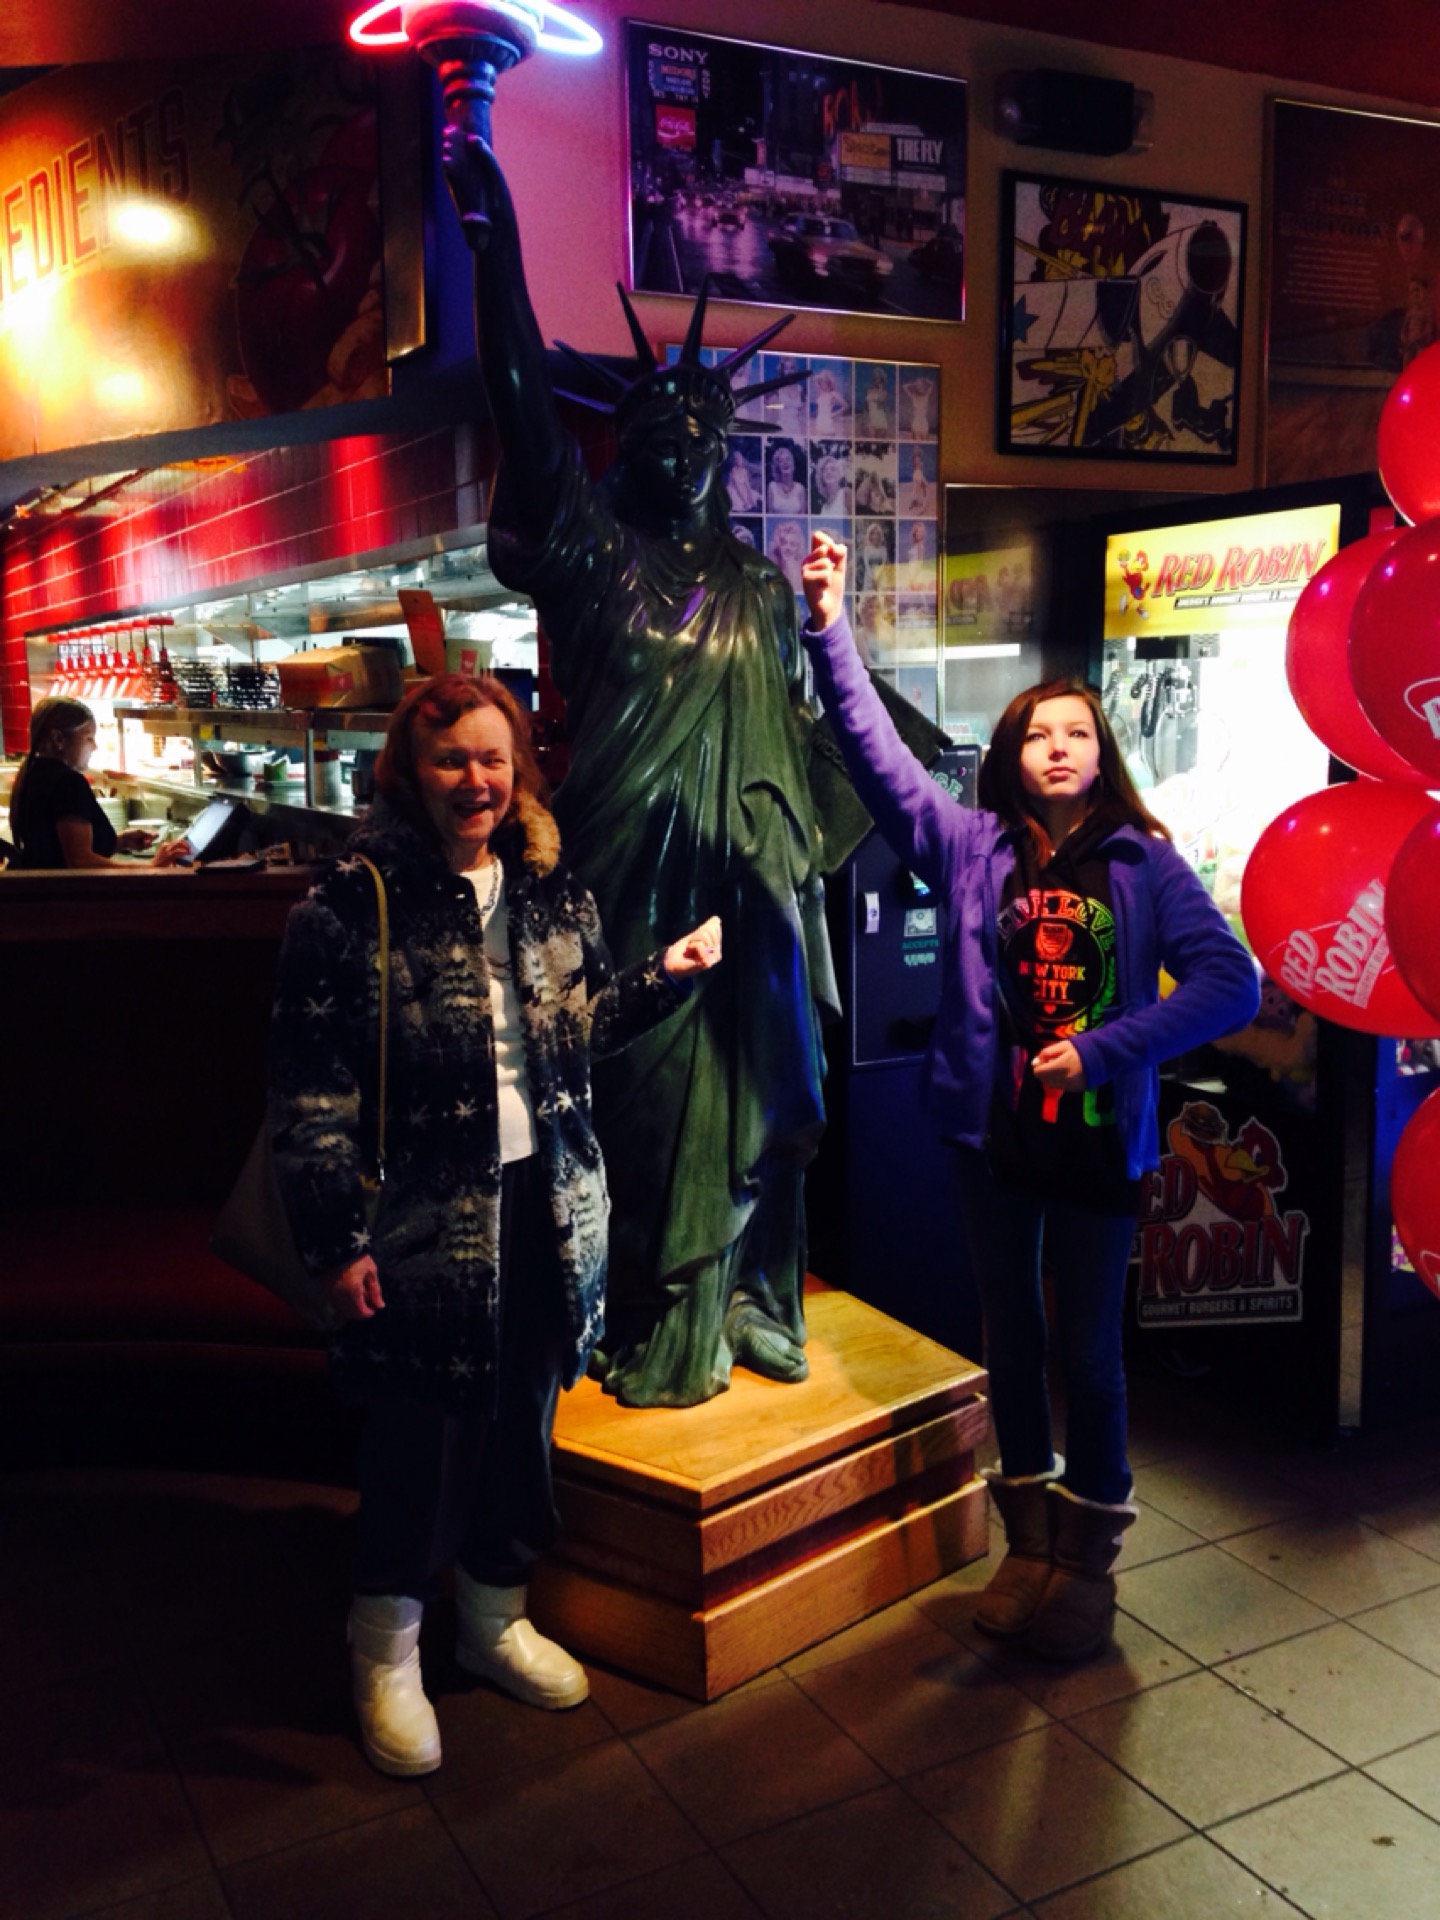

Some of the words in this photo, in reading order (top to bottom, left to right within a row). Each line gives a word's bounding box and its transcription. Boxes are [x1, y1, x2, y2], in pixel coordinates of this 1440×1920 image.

[648, 43, 708, 65] SONY
[896, 138, 919, 162] THE
[920, 139, 943, 165] FLY
[0, 85, 190, 301] EDIENTS
[1151, 552, 1215, 598] RED
[1214, 540, 1326, 591] ROBIN
[1018, 959, 1050, 978] NW
[1051, 963, 1086, 981] YORK
[1281, 930, 1318, 999] RED
[1315, 879, 1385, 1004] ROBIN
[1138, 1157, 1198, 1223] ED
[1141, 1213, 1305, 1297] ROBIN
[1142, 1303, 1186, 1317] GOURMET
[1189, 1299, 1236, 1315] BURGERS
[1249, 1295, 1294, 1312] SPIRITS
